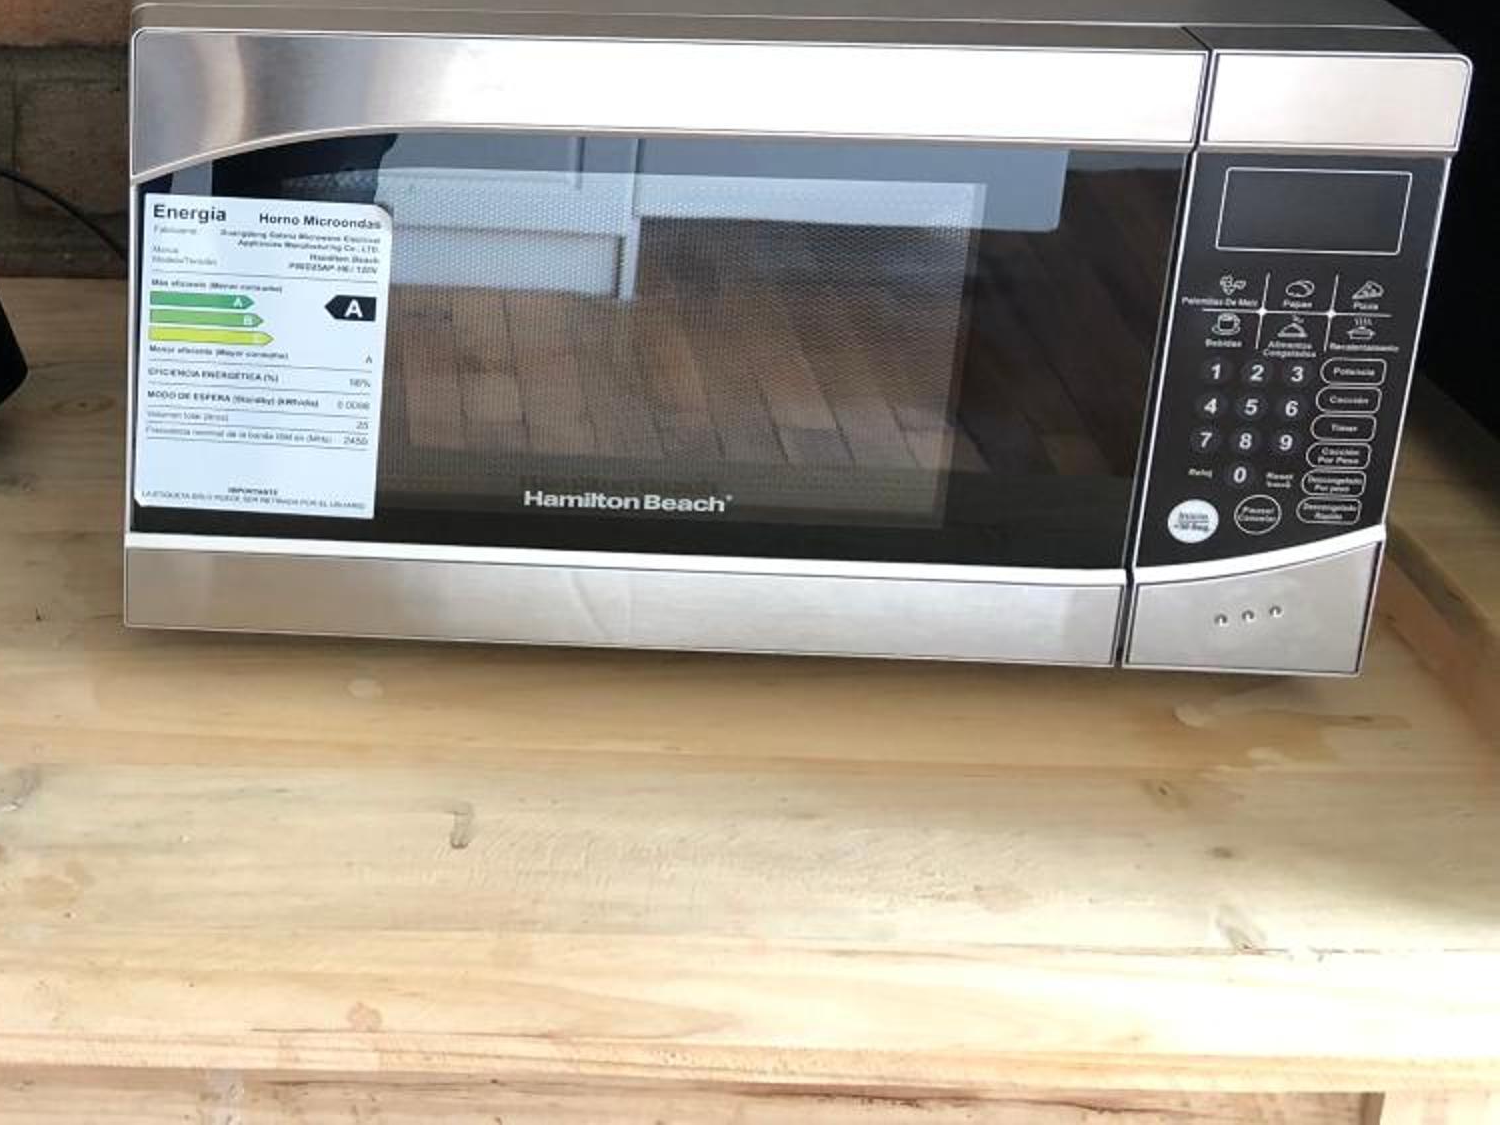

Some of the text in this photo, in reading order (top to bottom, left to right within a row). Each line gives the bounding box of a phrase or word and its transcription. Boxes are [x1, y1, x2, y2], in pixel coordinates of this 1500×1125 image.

[259, 213, 382, 230] Horno Microondas
[233, 296, 243, 308] A
[344, 299, 363, 318] A
[1211, 363, 1304, 383] 1 2 3
[147, 389, 176, 400] MODO
[178, 391, 191, 401] DE
[1203, 397, 1299, 417] 4 5 6
[1199, 431, 1293, 452] 7 8 9
[1233, 466, 1248, 484] 0
[523, 490, 726, 513] Hamilton Beach
